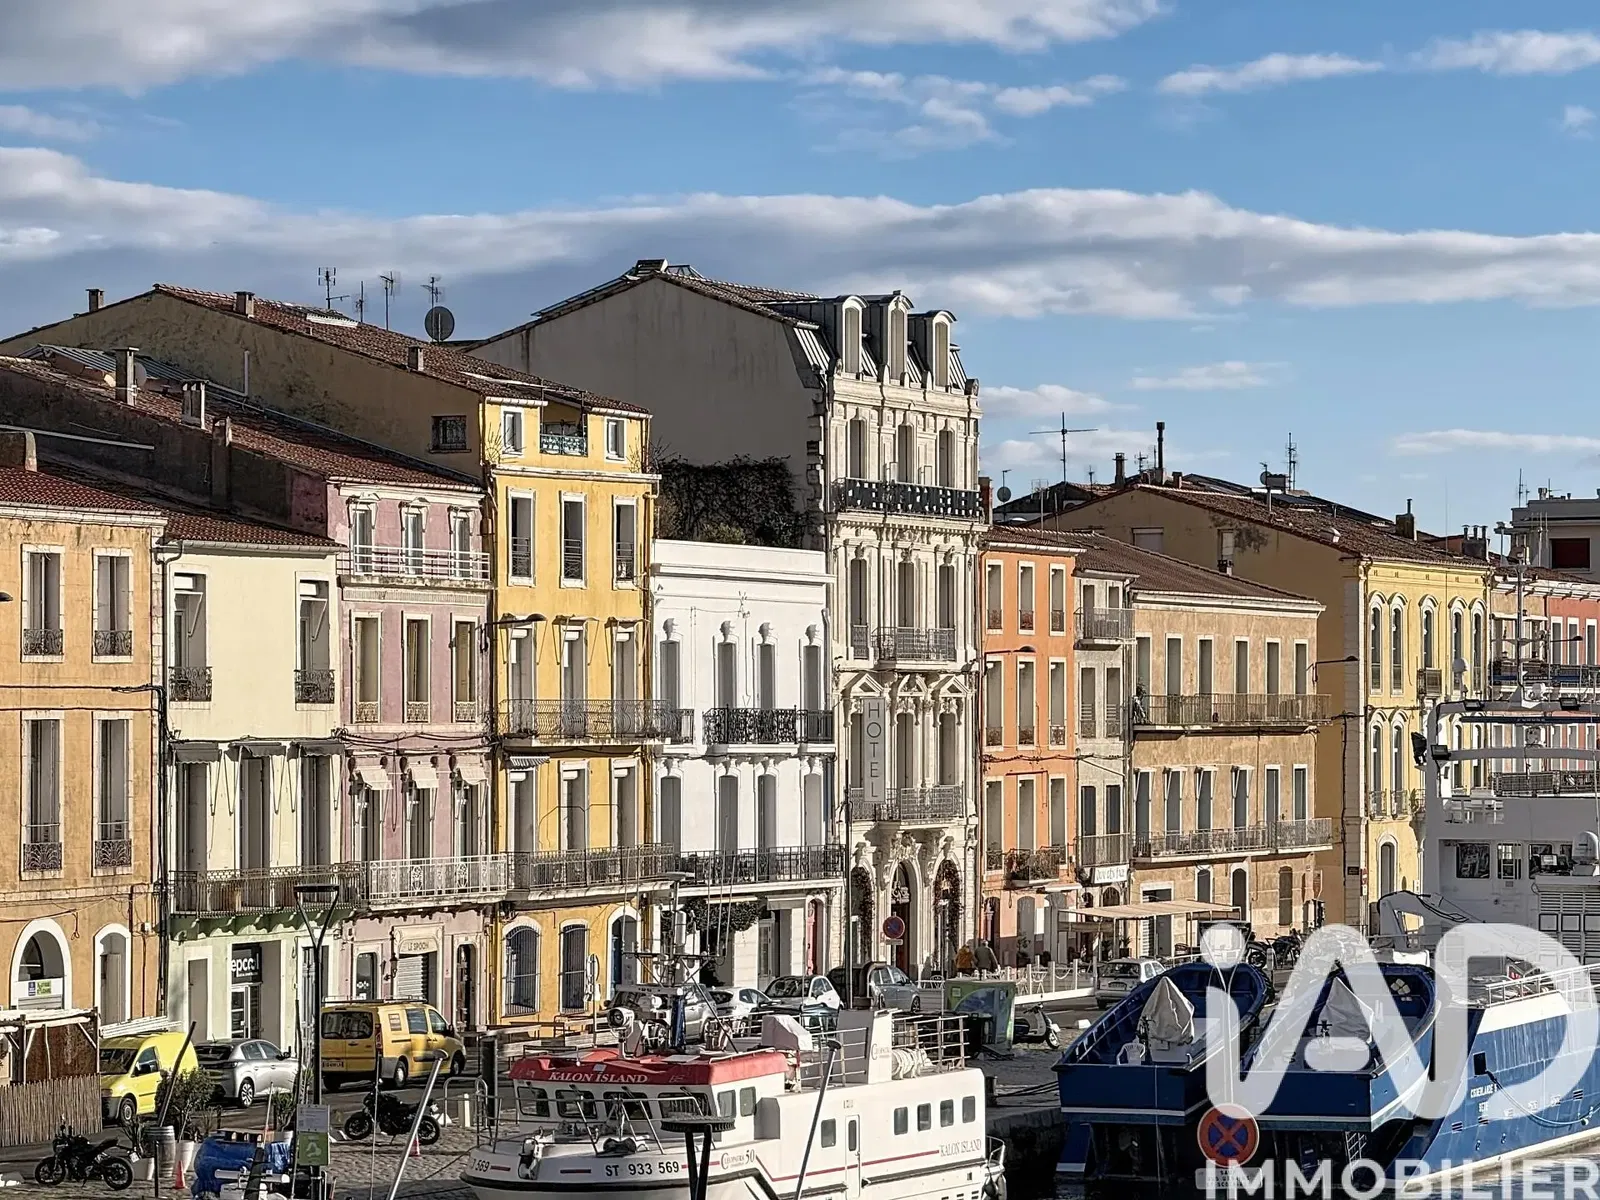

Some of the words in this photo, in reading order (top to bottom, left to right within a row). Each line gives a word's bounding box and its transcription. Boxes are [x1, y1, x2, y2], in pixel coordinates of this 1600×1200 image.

[866, 701, 882, 798] HOTEL
[548, 1071, 592, 1082] KALON
[595, 1072, 648, 1084] ISLAND
[940, 1142, 960, 1157] KALON
[961, 1139, 982, 1154] ISLAND
[745, 1149, 755, 1165] 50
[605, 1164, 620, 1177] ST
[628, 1163, 653, 1176] 933
[658, 1160, 680, 1174] 569
